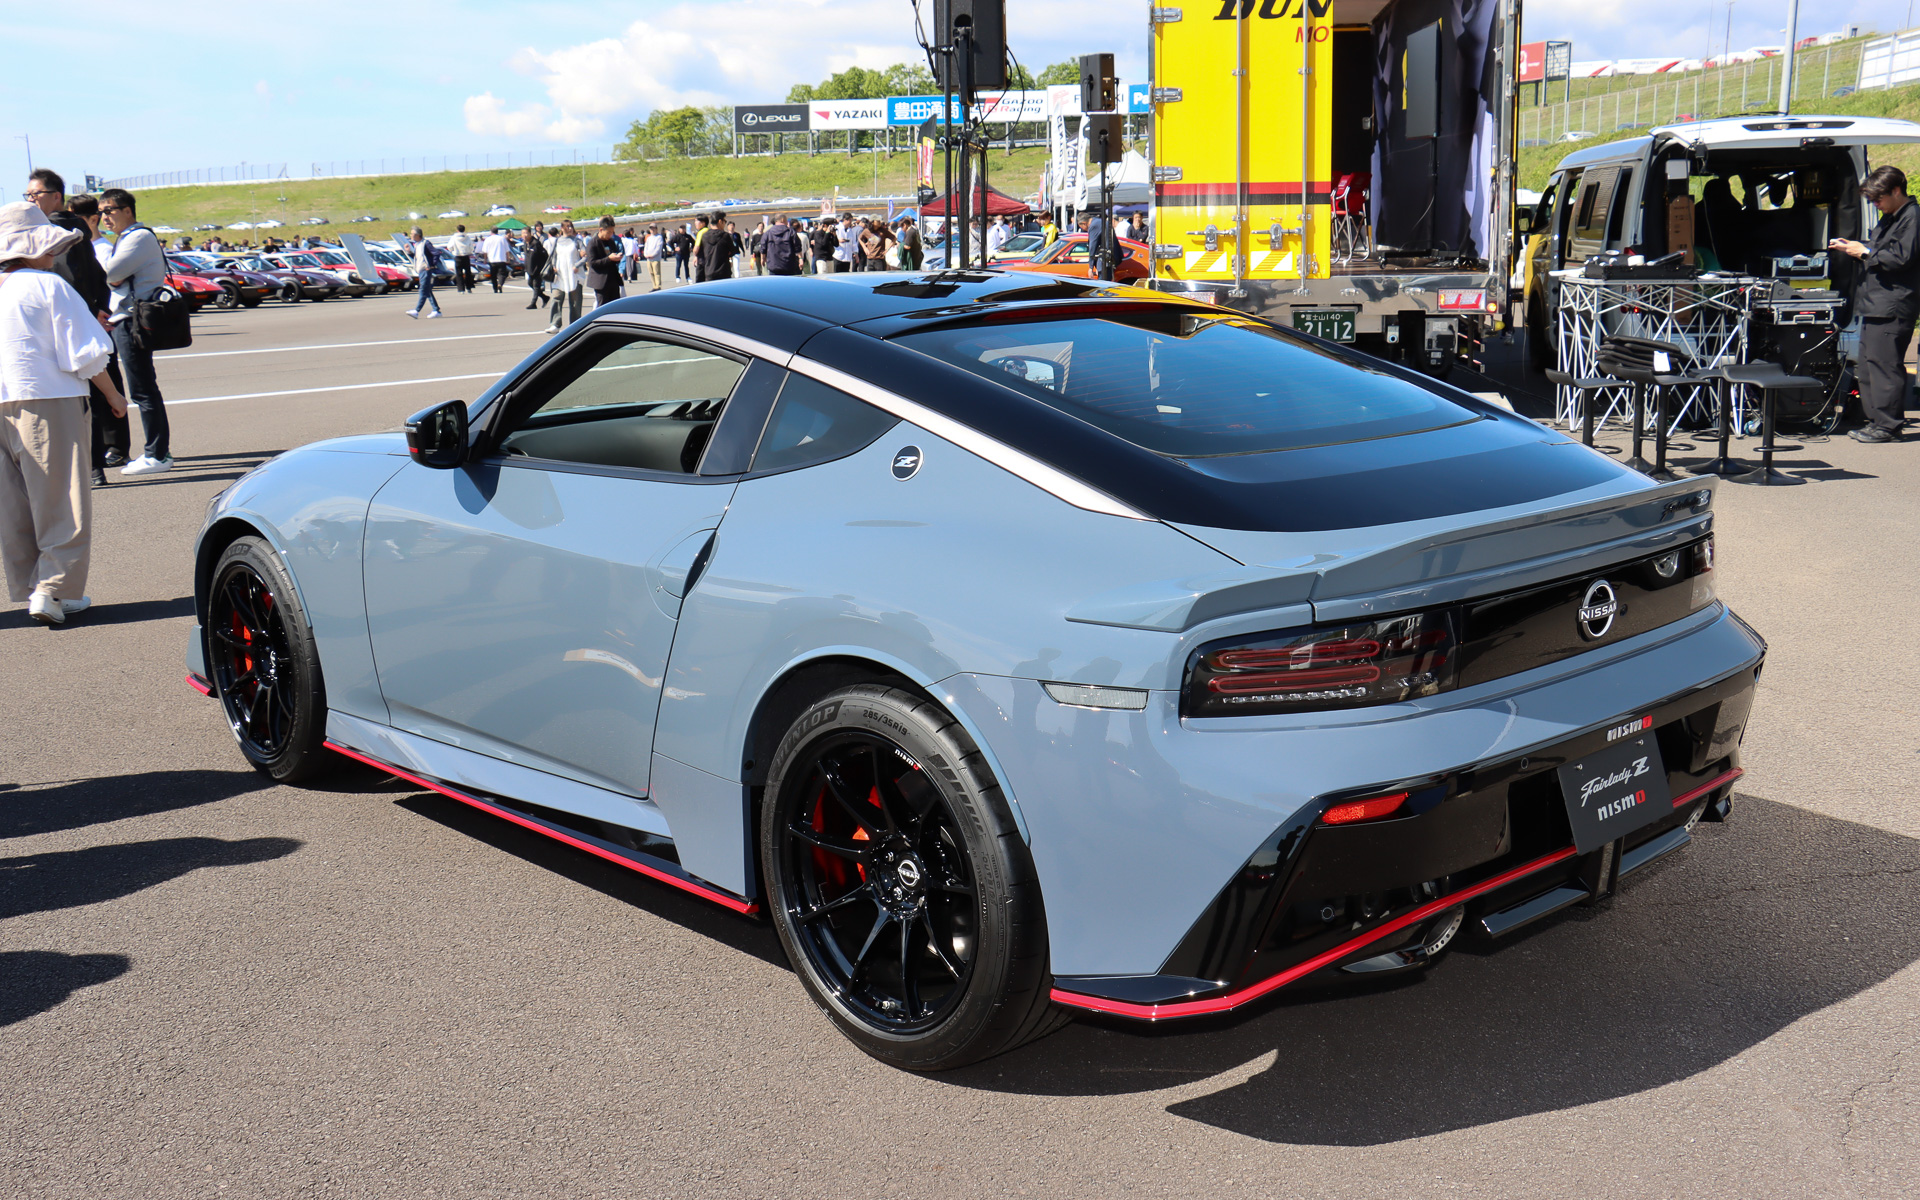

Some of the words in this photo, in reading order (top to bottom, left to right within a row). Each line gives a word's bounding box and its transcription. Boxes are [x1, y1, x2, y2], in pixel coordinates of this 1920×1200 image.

[1295, 26, 1333, 43] MO
[759, 114, 801, 123] LEXUS
[834, 109, 883, 119] YAZAKI
[893, 101, 960, 120] 豊田通商
[1580, 602, 1617, 620] NISSAN
[862, 709, 908, 736] 285/35R19
[1580, 767, 1633, 808] Fairlady
[1631, 756, 1650, 777] Z
